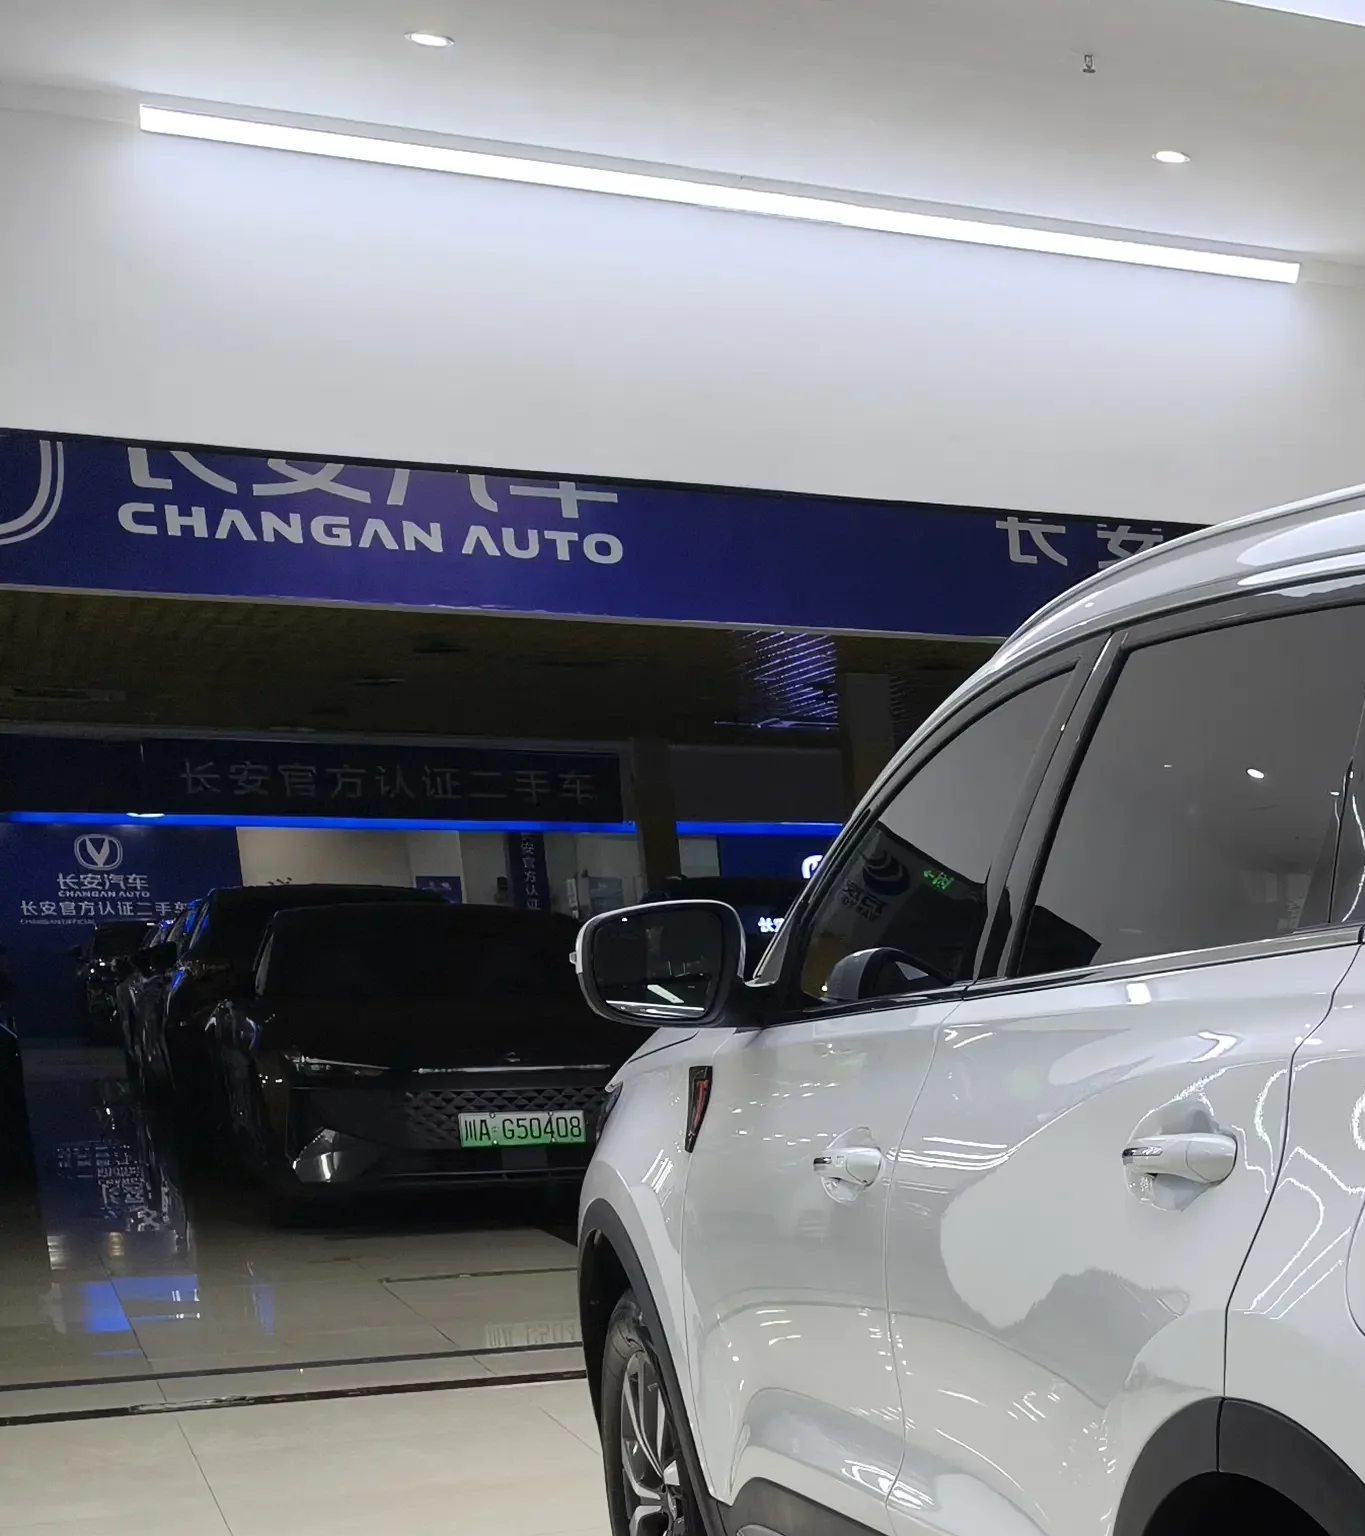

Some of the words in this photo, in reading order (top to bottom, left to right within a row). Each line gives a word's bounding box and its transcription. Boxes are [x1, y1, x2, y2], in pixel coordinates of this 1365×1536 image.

[117, 502, 443, 553] CHANGAN
[461, 524, 624, 565] AUTO
[180, 758, 598, 805] 长安官方认证二手车
[57, 872, 149, 890] 长安汽车
[20, 900, 187, 916] 长安官方认证二手车
[502, 1116, 582, 1139] G50408
